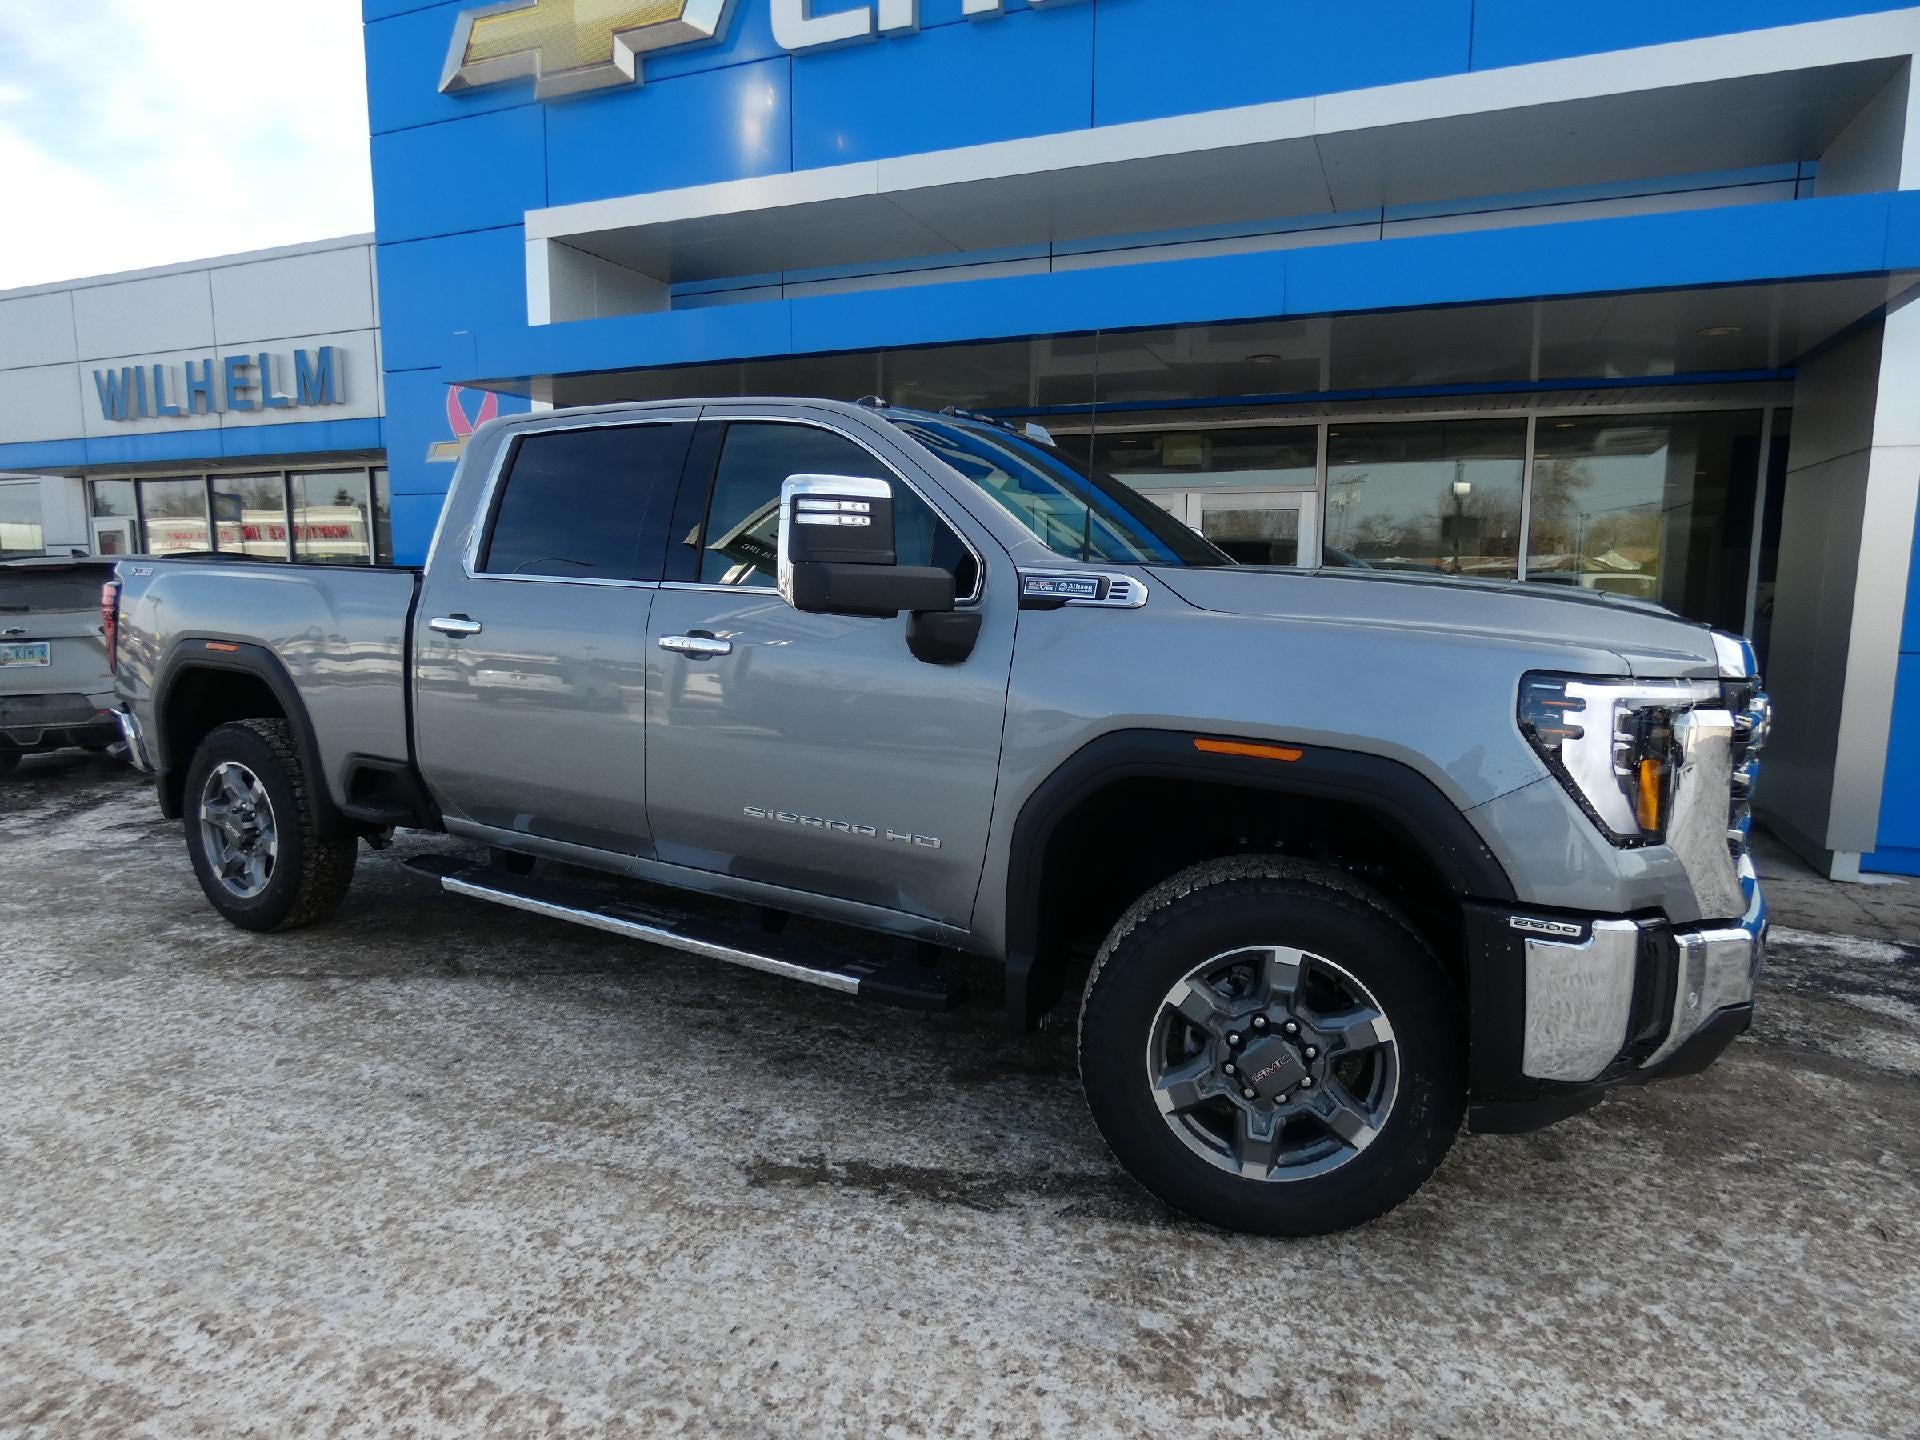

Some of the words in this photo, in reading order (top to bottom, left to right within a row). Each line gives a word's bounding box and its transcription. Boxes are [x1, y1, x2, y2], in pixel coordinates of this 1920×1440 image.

[93, 346, 341, 421] WILHELM
[743, 806, 878, 838] SIERRA
[886, 829, 942, 849] HD
[1251, 1054, 1293, 1084] GMC
